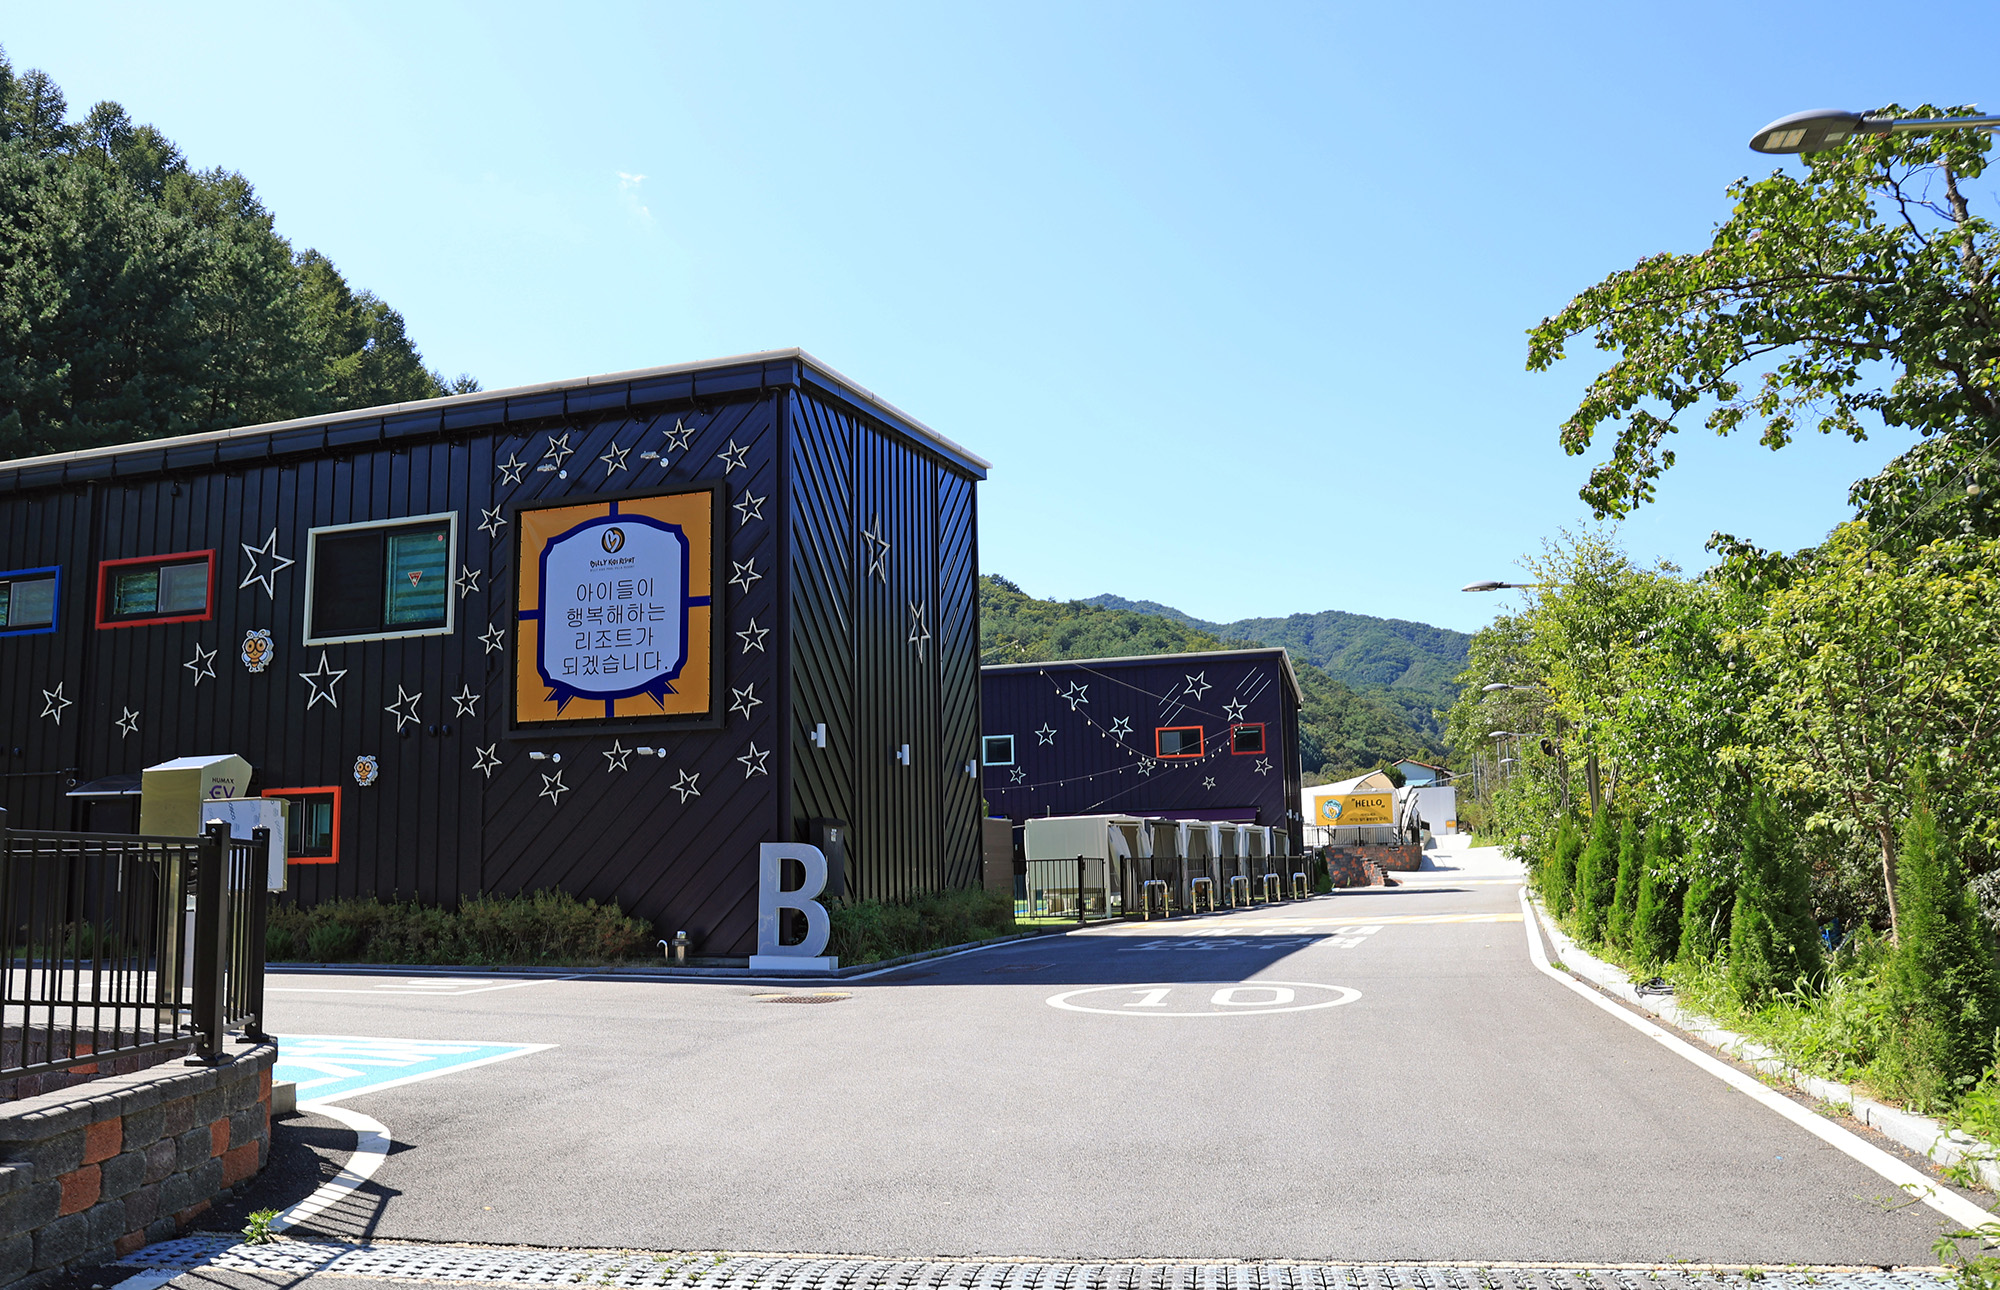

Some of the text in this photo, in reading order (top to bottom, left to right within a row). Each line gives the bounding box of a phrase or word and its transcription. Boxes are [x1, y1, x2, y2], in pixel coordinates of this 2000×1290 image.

[576, 577, 653, 602] 아이들이
[567, 602, 665, 628] 행복해하는
[575, 627, 653, 651] 리조트가
[562, 651, 668, 676] 되겠습니다.
[209, 785, 235, 799] EV
[758, 842, 830, 957] B
[1123, 987, 1295, 1008] 10
